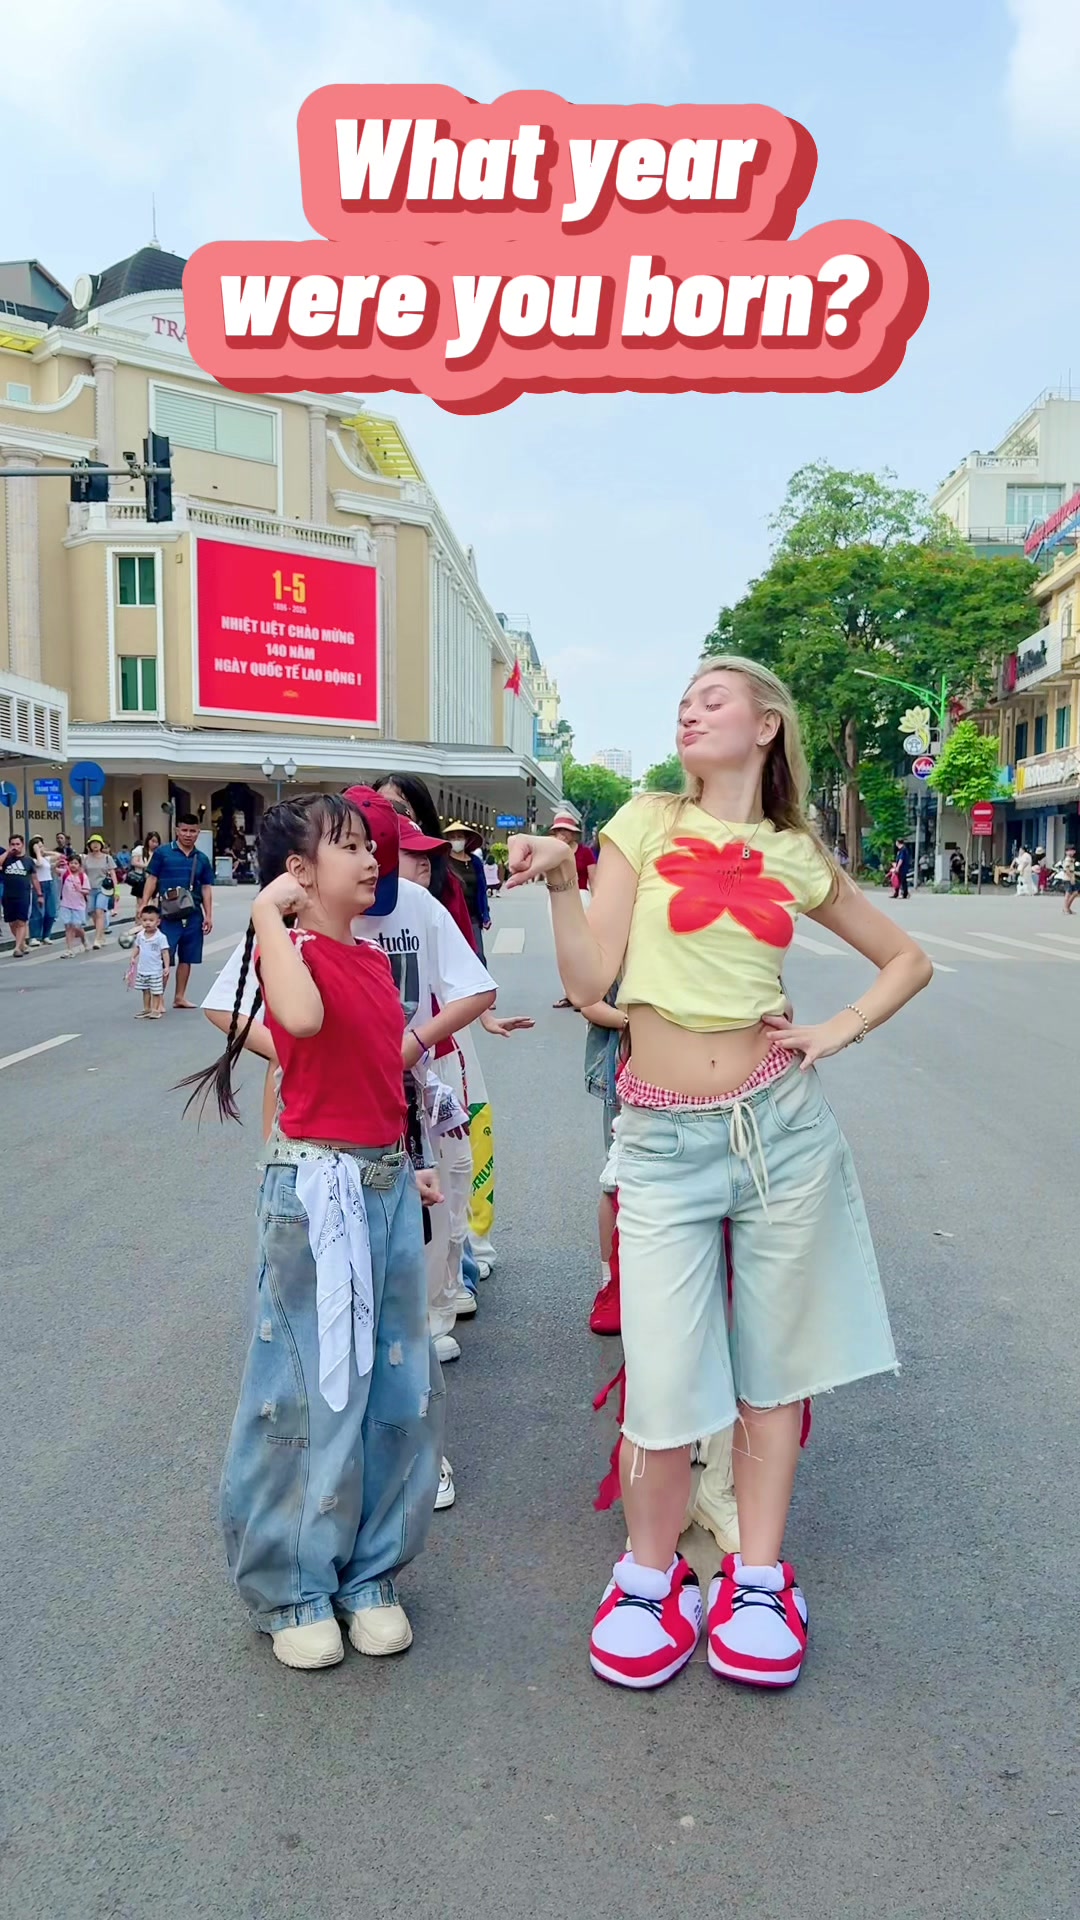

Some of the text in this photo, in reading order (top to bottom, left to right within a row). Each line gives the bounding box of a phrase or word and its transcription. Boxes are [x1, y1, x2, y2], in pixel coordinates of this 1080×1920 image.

[272, 570, 306, 603] 1-5
[221, 615, 355, 646] NHIỆT LIỆT CHÀO MỪNG
[265, 643, 315, 661] 140 NĂM
[214, 657, 248, 675] NGÀY
[250, 660, 283, 679] QUỐC
[285, 664, 300, 680] TẾ
[301, 667, 323, 683] LAO
[324, 668, 356, 687] ĐỘNG
[373, 928, 420, 953] tudio
